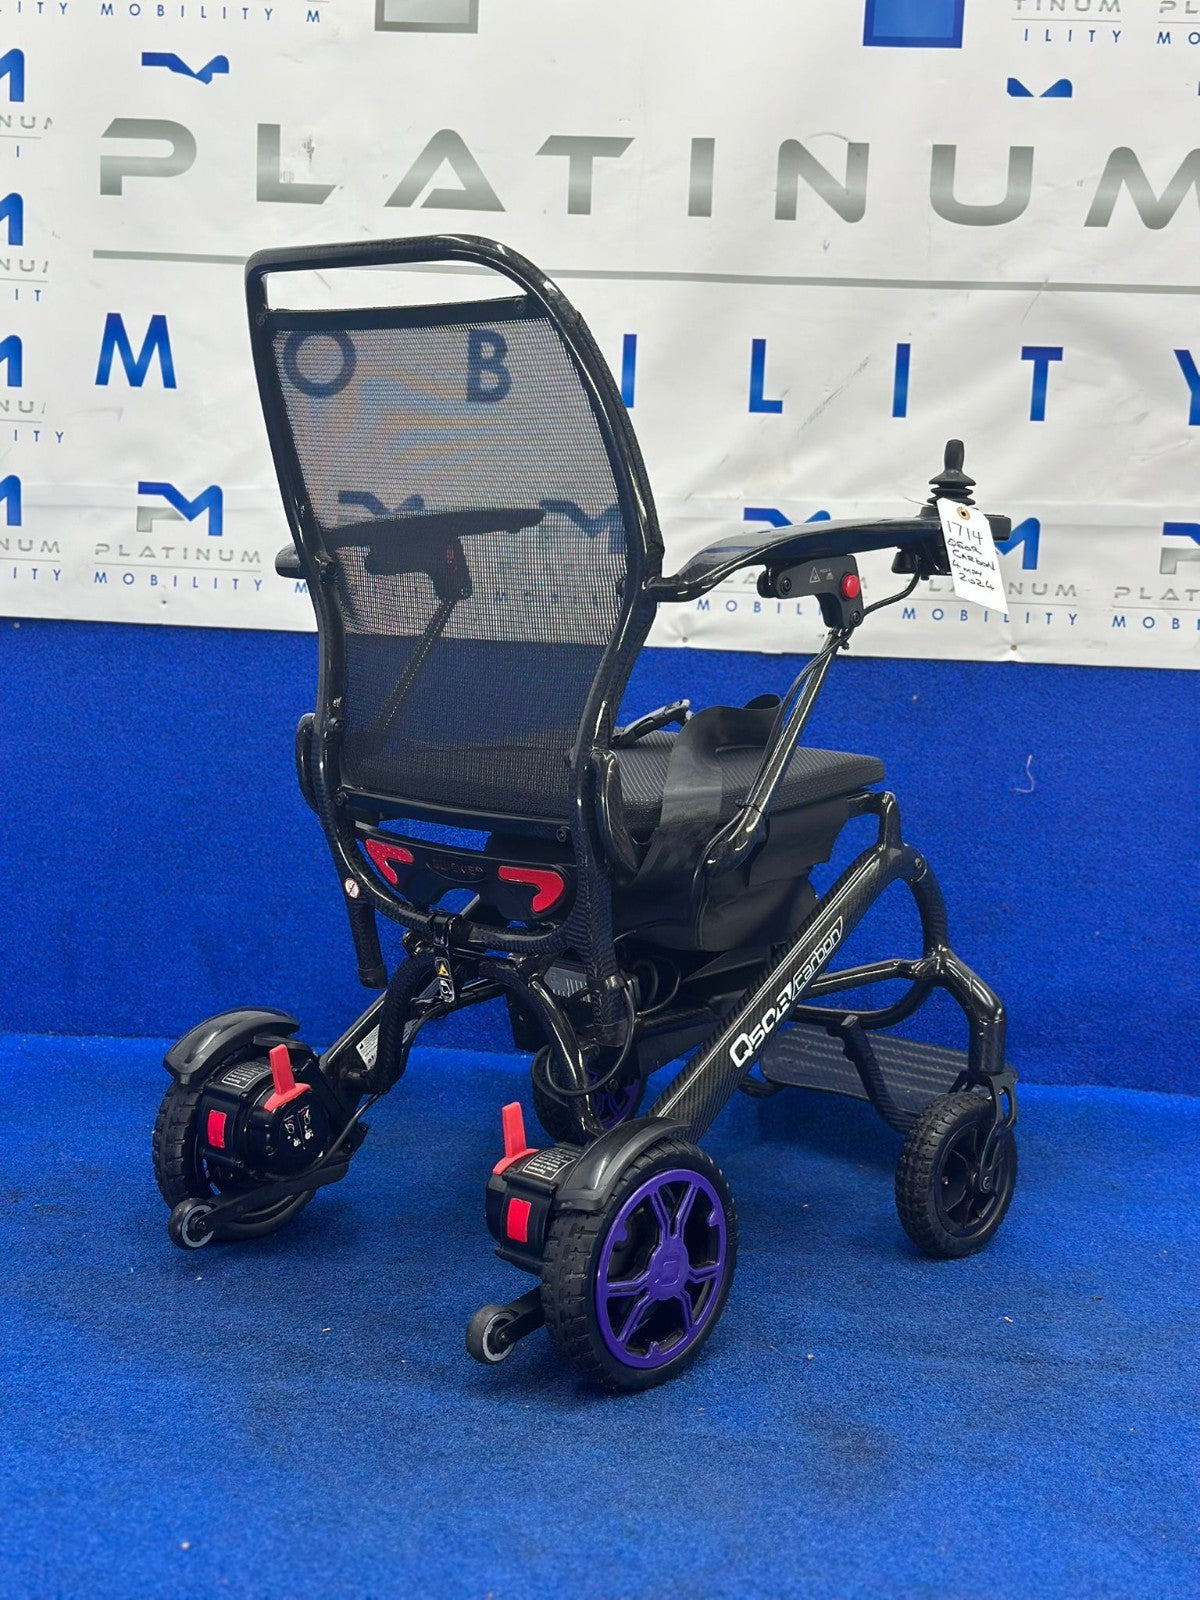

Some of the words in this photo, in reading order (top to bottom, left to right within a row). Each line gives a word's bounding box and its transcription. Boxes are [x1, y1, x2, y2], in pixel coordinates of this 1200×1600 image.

[101, 4, 273, 21] MOBILITY
[100, 117, 1200, 230] PLATINUM
[947, 520, 983, 545] 1714
[95, 543, 261, 563] PLATINUM
[94, 572, 262, 591] MOBILITY
[959, 572, 995, 591] 2024
[902, 608, 1078, 626] MOBILITY
